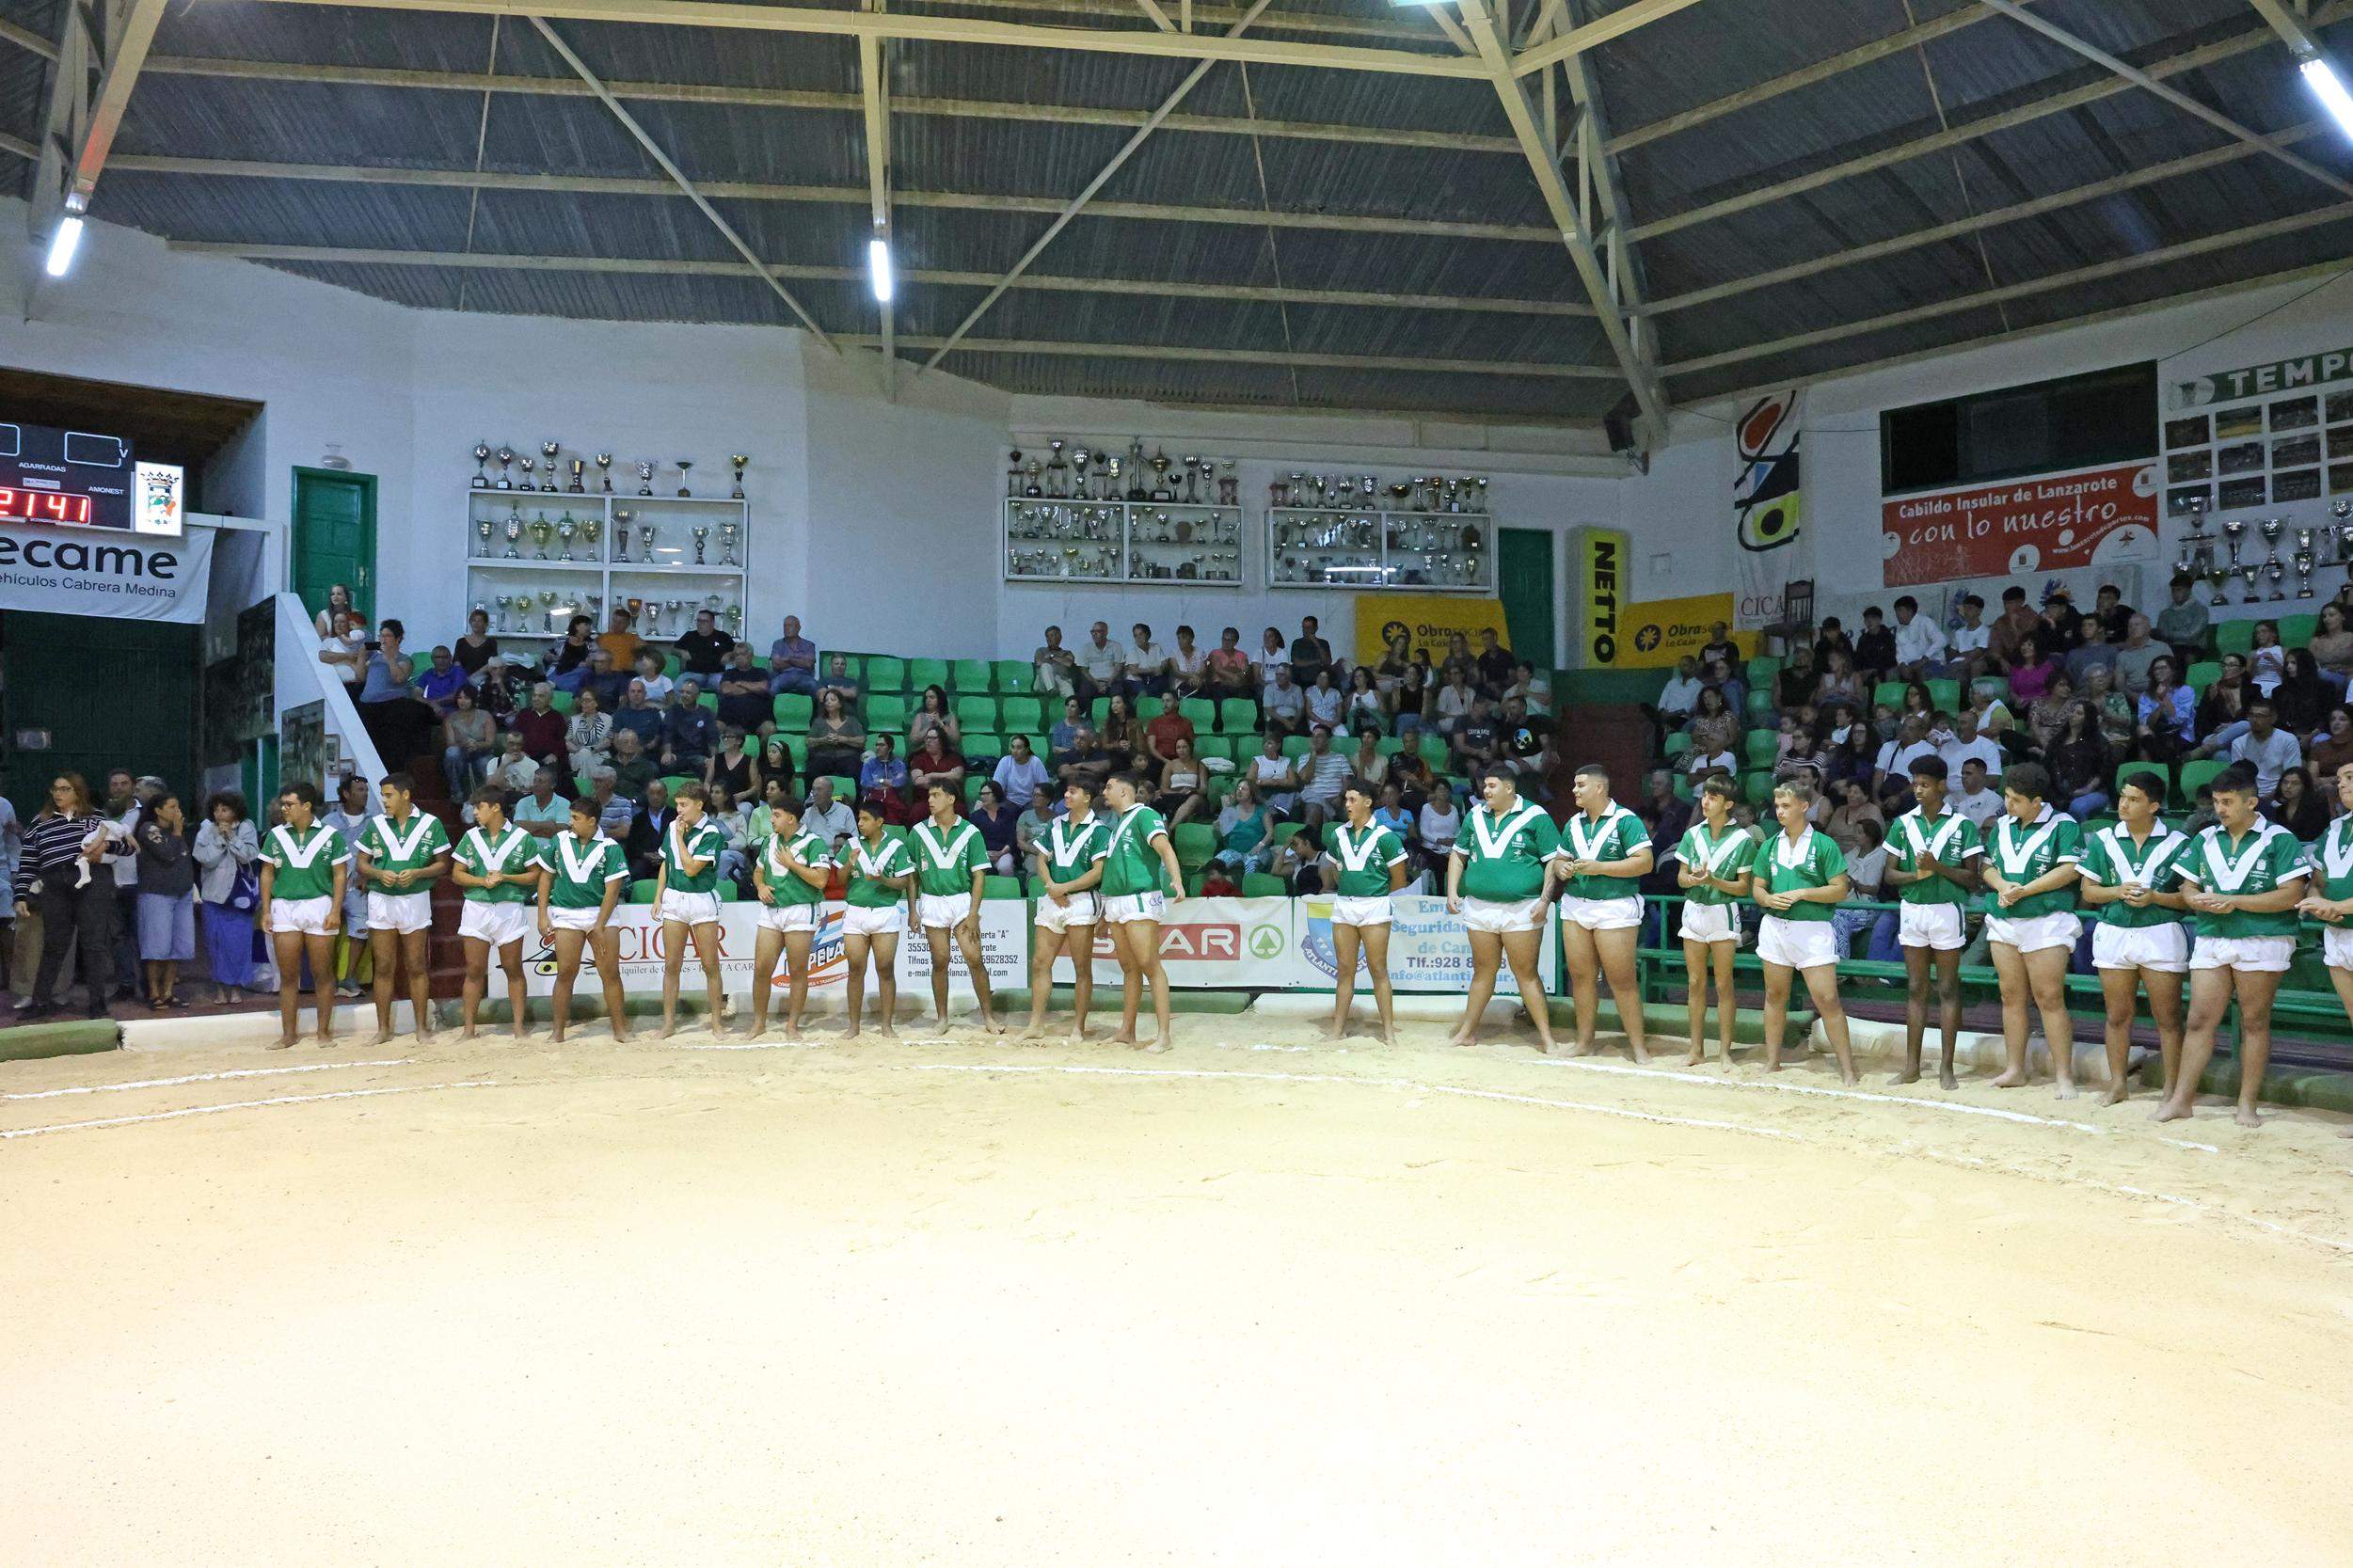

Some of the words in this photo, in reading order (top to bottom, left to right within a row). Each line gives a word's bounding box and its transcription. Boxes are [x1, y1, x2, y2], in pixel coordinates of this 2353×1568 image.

[2228, 353, 2353, 397] TEMP
[1900, 500, 1952, 518] Cabildo
[1957, 494, 2008, 510] Insular
[2013, 487, 2032, 502] de
[2037, 478, 2118, 499] Lanzarote
[1909, 523, 1956, 545] con
[1967, 511, 1991, 539] lo
[2003, 495, 2118, 533] nuestro
[0, 572, 57, 588] hículos
[62, 577, 120, 594] Cabrera
[125, 582, 176, 598] Medina
[1594, 541, 1615, 663] NETTO
[1741, 595, 1786, 616] CICA
[1092, 927, 1234, 956] SAR
[1417, 941, 1437, 954] de
[621, 965, 647, 975] lquiler
